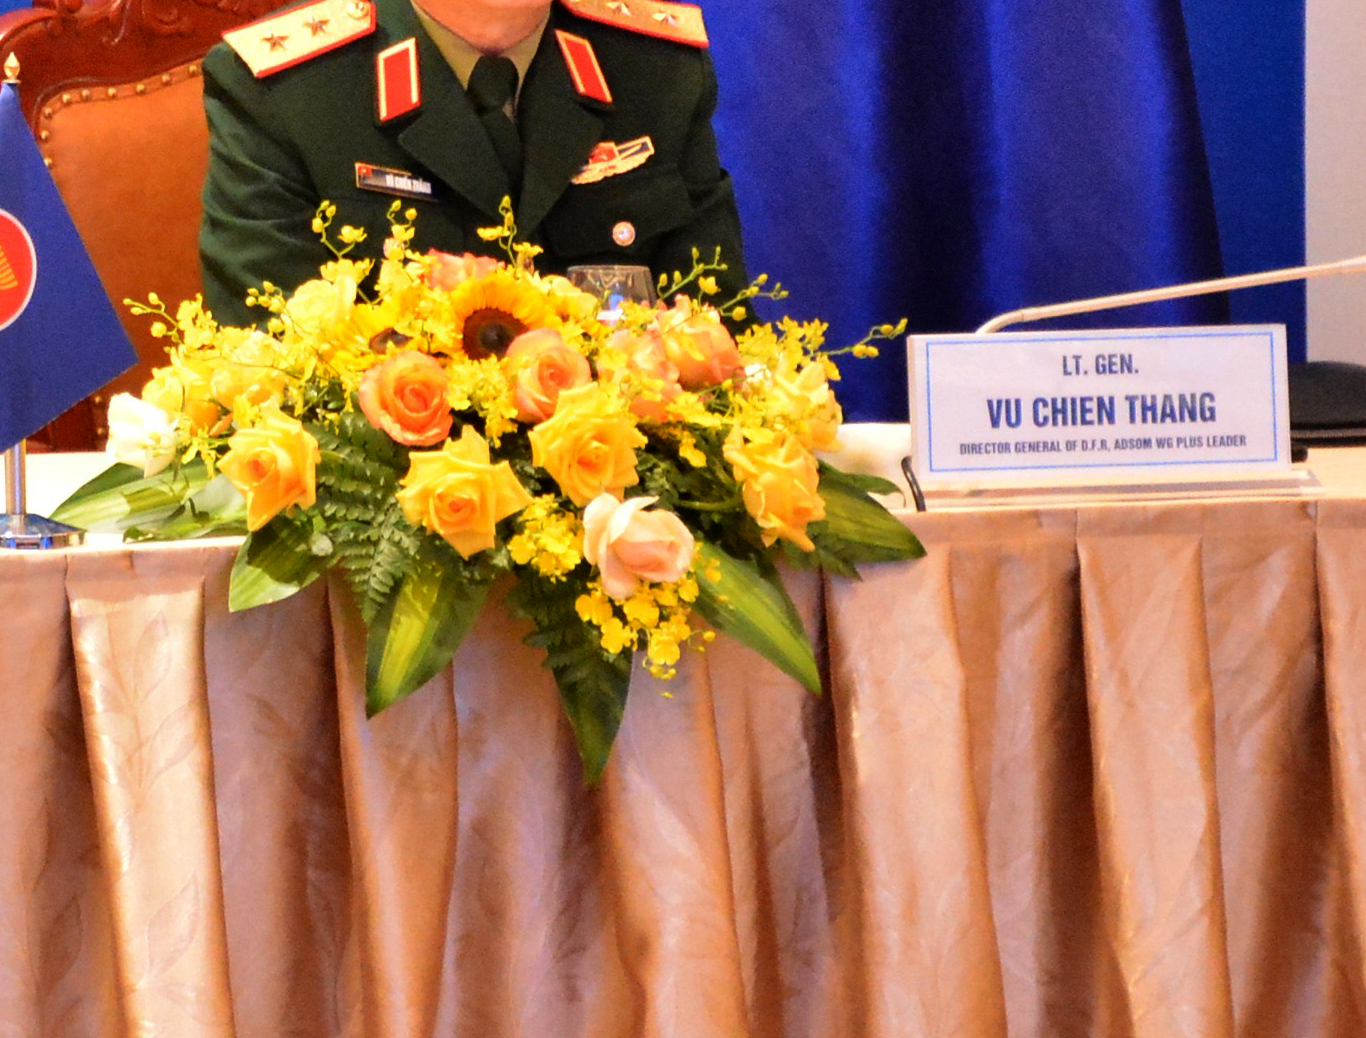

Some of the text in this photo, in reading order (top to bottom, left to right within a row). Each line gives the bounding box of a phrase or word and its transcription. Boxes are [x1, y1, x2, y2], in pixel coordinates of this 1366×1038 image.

[1063, 354, 1138, 376] LT. GEN.
[987, 392, 1216, 428] VU CHIEN THANG
[960, 442, 1011, 455] DIRECTOR
[1015, 441, 1061, 453] GENERAL
[1065, 440, 1077, 451] OF
[1114, 438, 1152, 450] ADSOM
[1156, 437, 1173, 449] WG
[1176, 436, 1203, 448] PLUS
[1207, 435, 1246, 447] LEADER
